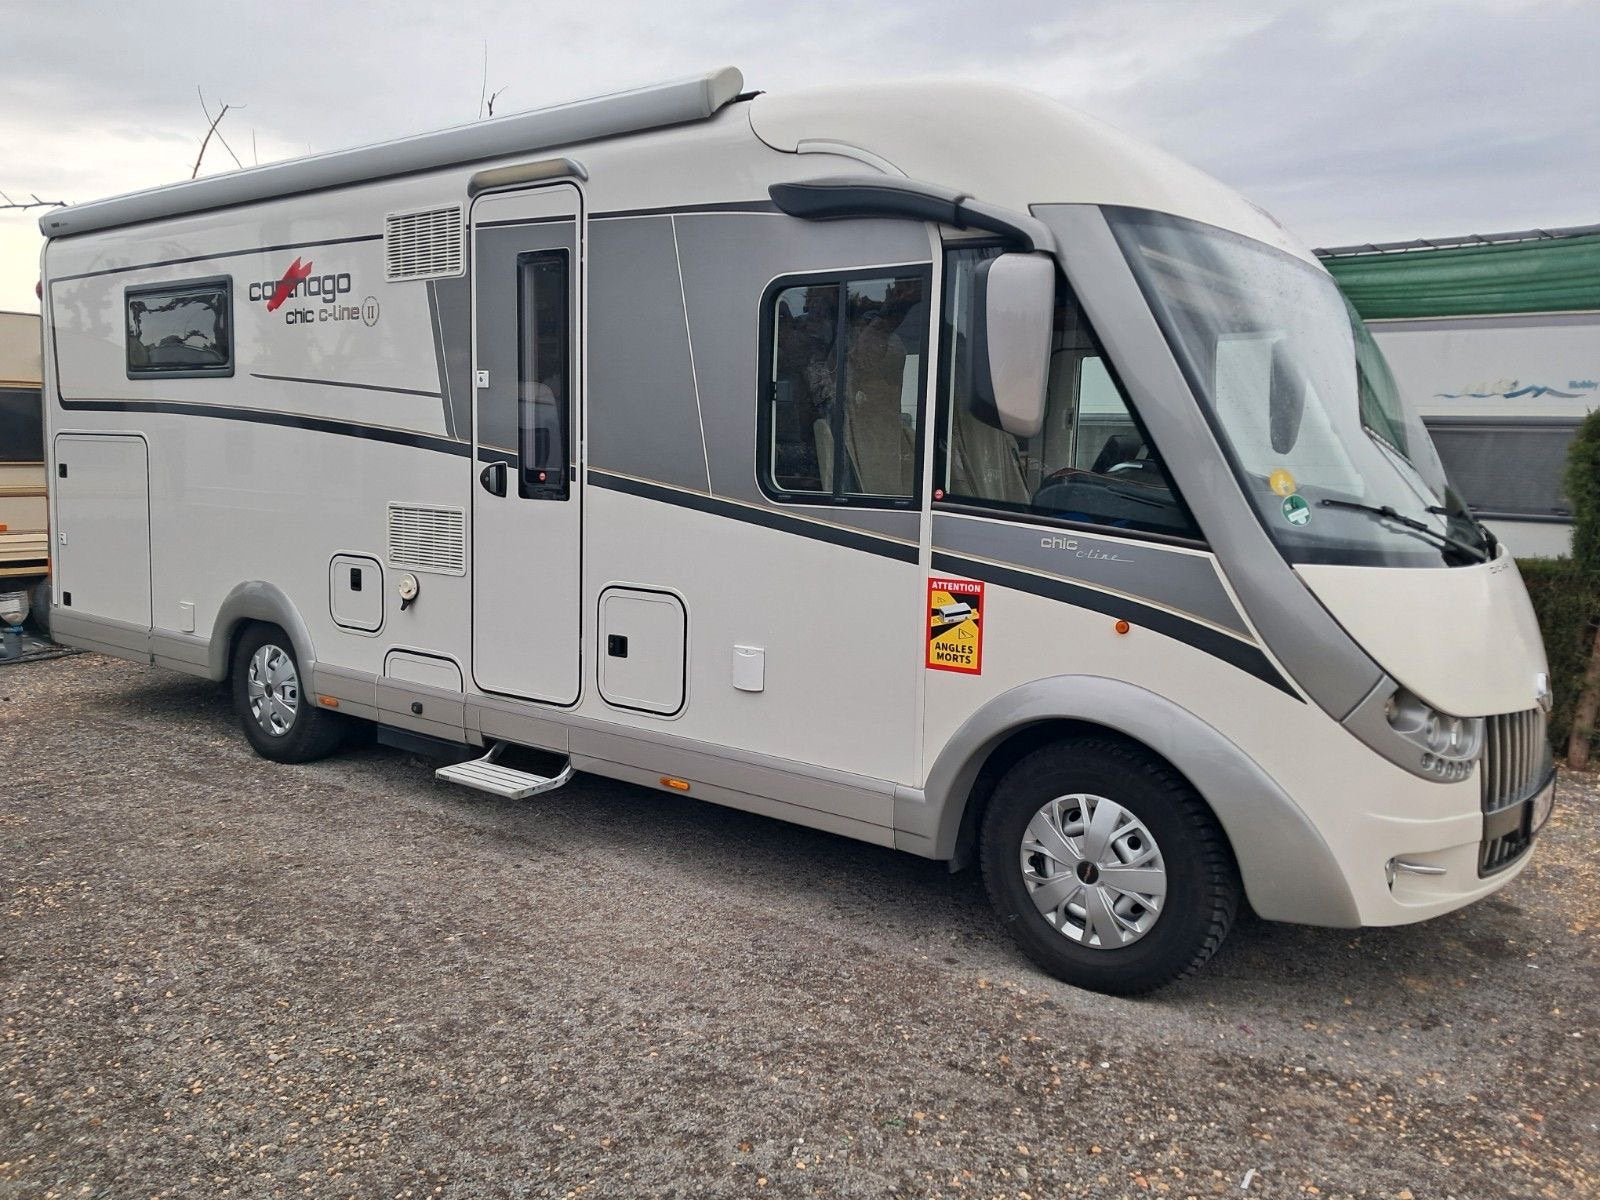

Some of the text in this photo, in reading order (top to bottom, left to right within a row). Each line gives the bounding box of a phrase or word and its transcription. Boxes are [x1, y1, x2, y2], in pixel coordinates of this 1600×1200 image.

[285, 308, 315, 324] chic
[318, 304, 360, 321] c-line
[1041, 537, 1078, 550] chic
[932, 581, 981, 592] ATTENTION
[935, 642, 973, 654] ANGLES
[936, 652, 971, 664] MORTS
